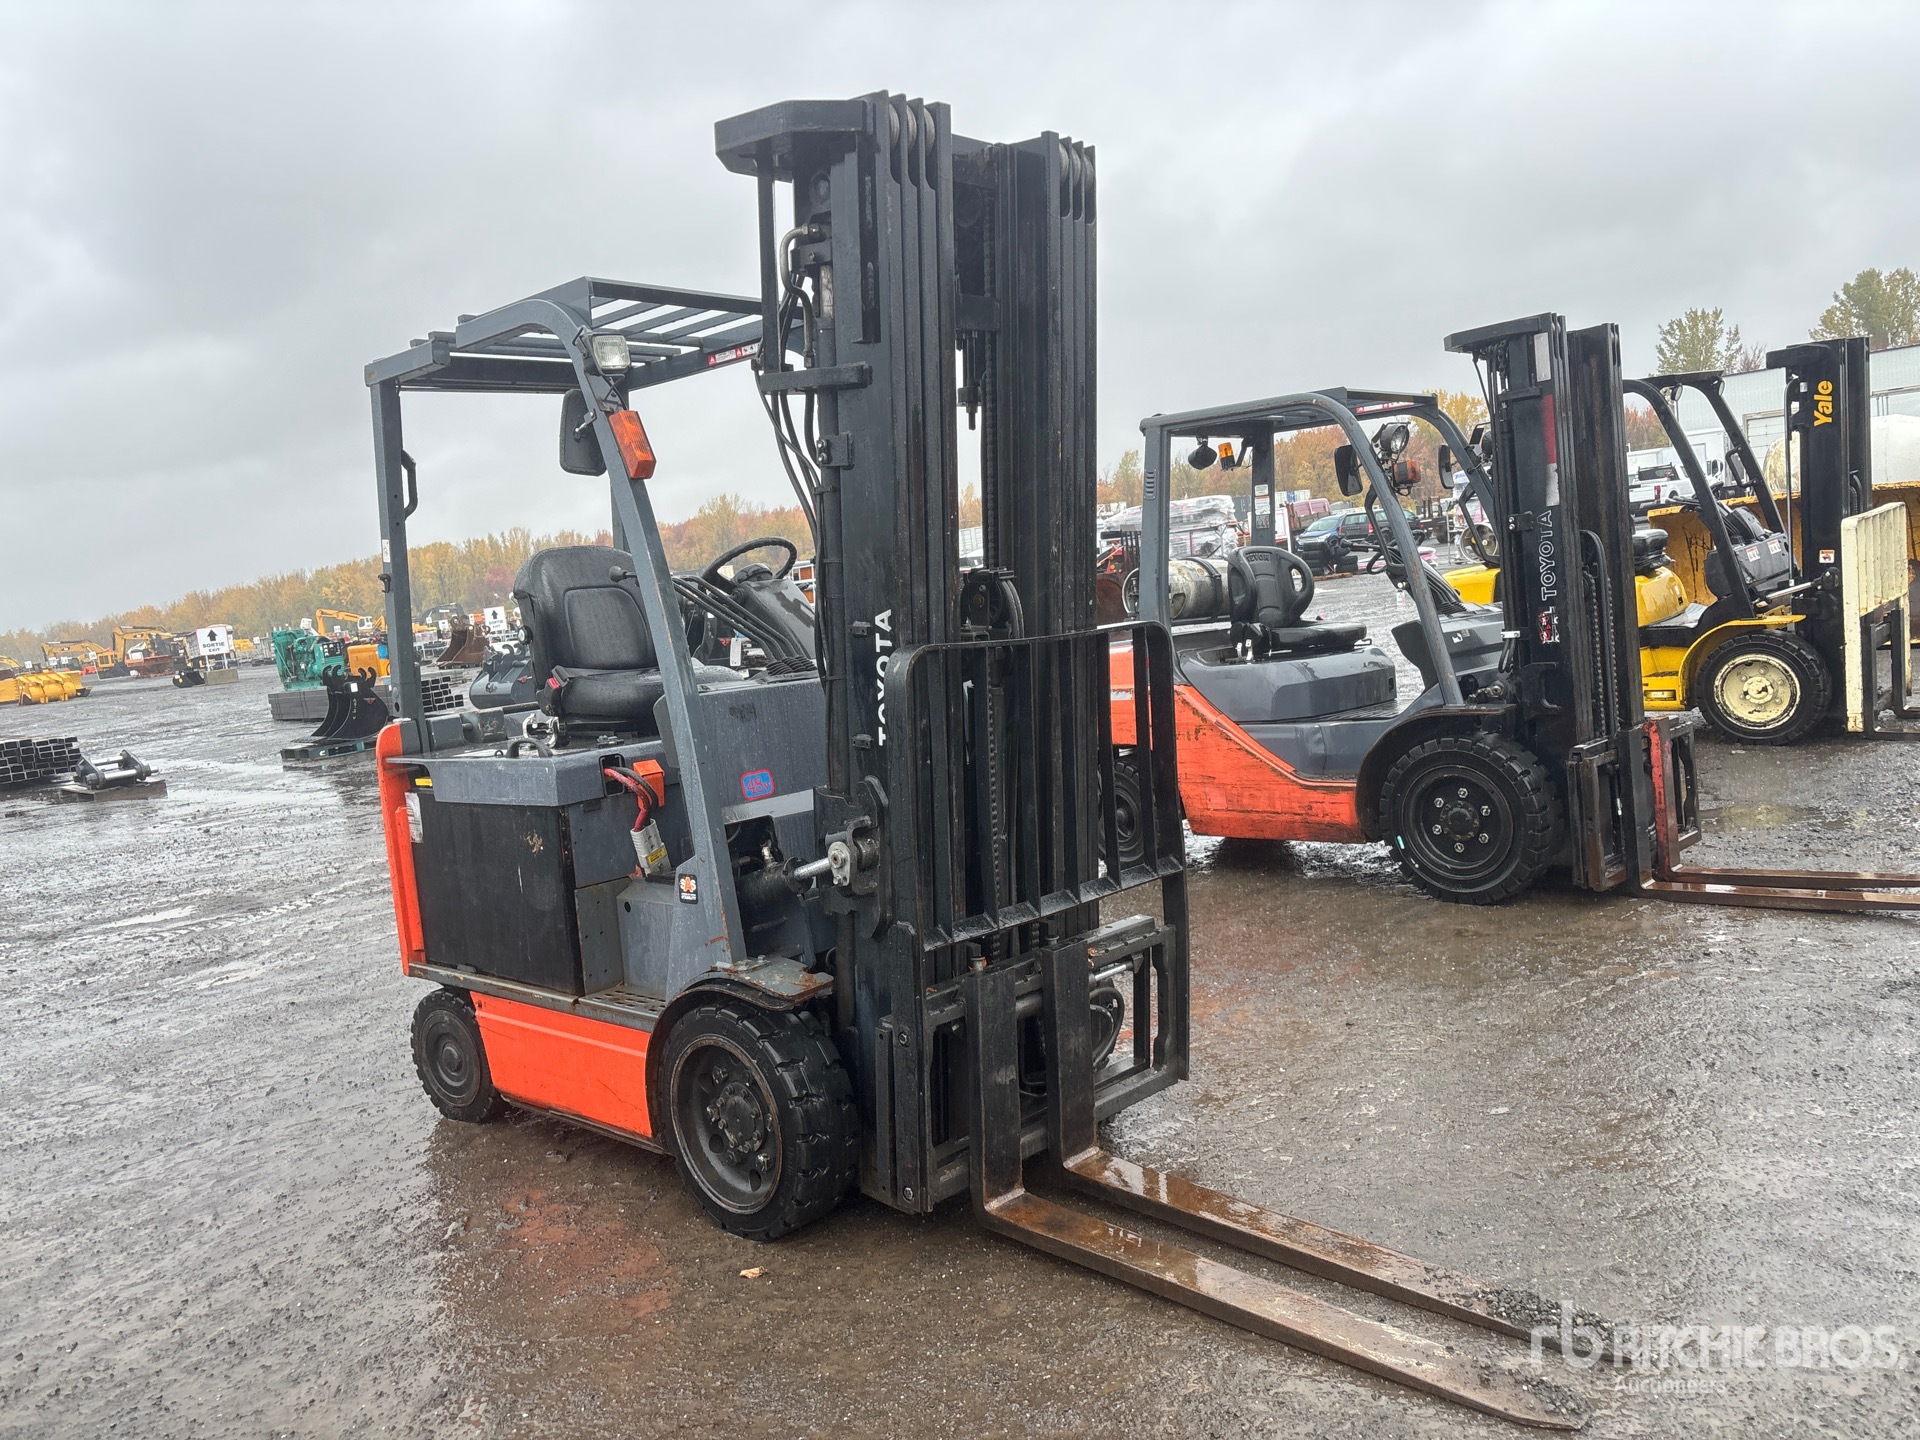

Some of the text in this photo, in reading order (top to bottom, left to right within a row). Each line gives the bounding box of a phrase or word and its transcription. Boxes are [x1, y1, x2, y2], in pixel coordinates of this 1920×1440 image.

[1813, 380, 1833, 427] Yale
[1537, 510, 1557, 601] TOYOTA
[202, 641, 225, 649] SORTIE
